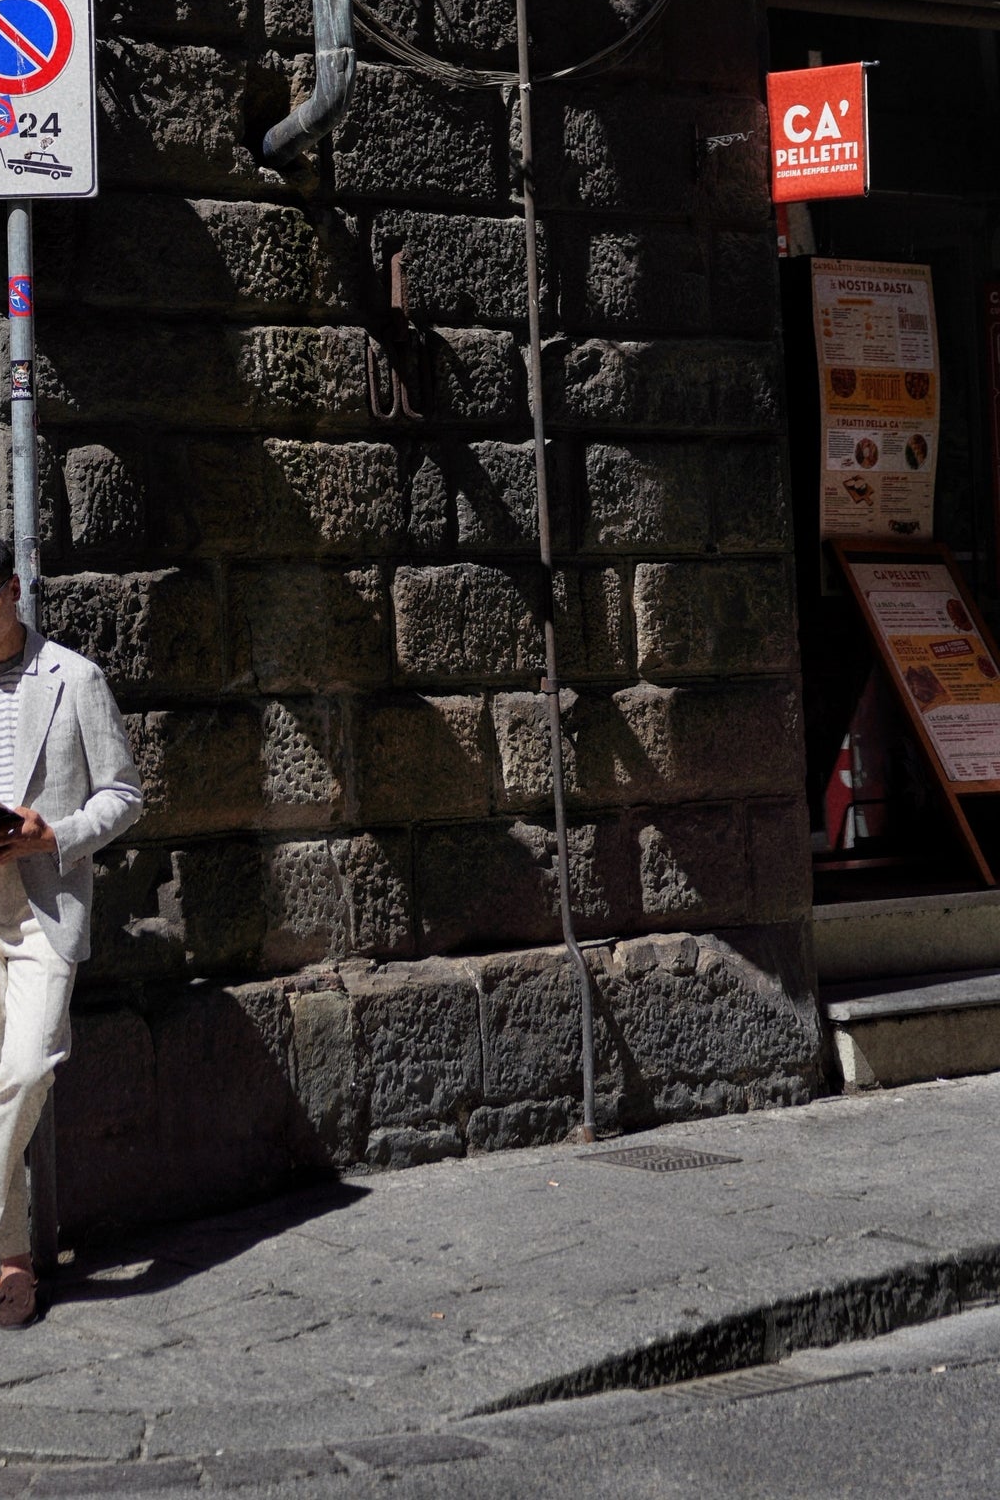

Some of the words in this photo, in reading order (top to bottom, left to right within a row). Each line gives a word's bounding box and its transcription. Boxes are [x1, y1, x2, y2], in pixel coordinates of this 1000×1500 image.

[783, 99, 850, 144] CA'
[775, 141, 859, 167] PELLETTI
[776, 169, 802, 179] CUCINA
[803, 166, 829, 177] SEMPRE
[830, 163, 858, 173] APERTA
[838, 279, 882, 293] NOSTRA
[884, 282, 914, 295] PASTA
[841, 418, 864, 428] PIATTI
[866, 419, 888, 429] DELLA
